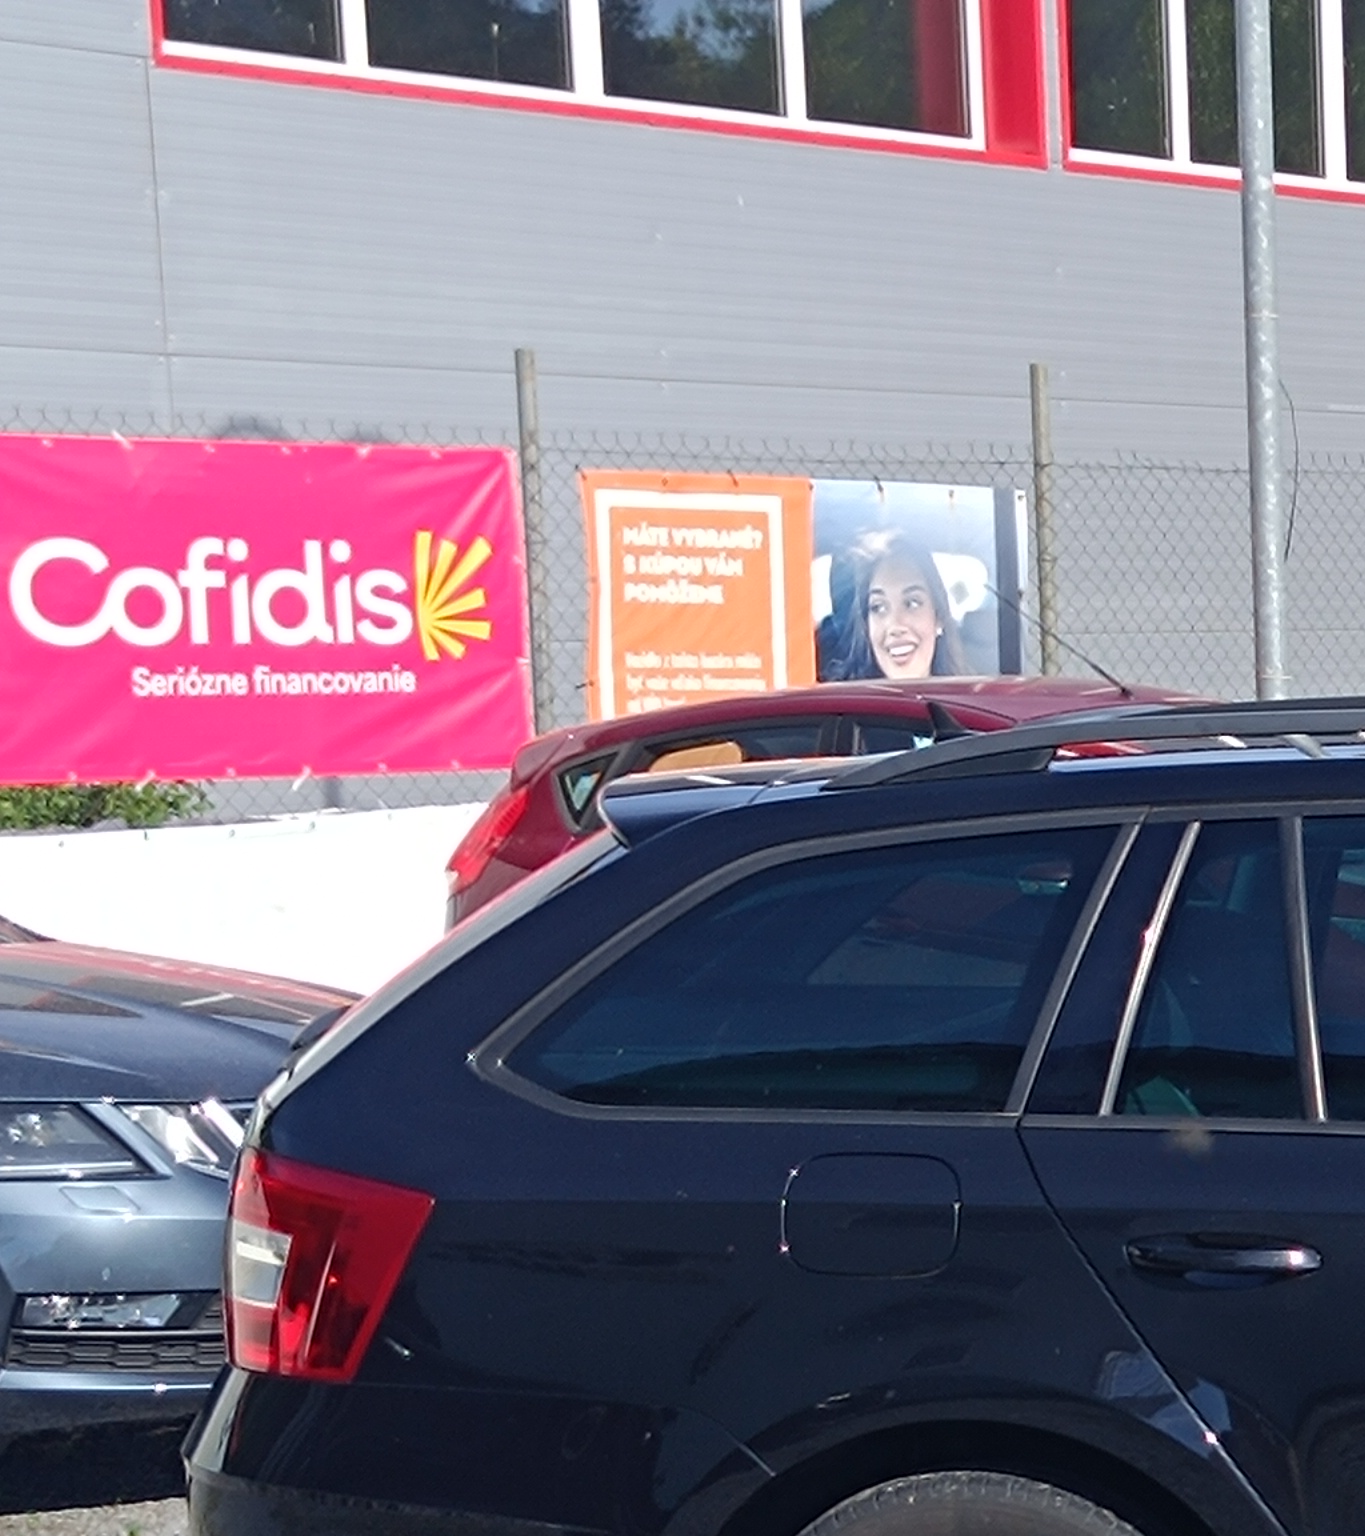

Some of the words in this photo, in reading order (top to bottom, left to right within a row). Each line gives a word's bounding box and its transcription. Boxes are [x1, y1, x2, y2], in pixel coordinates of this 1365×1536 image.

[8, 536, 414, 648] Cofidis
[131, 664, 249, 697] Seriózne
[253, 663, 416, 695] financovanie
